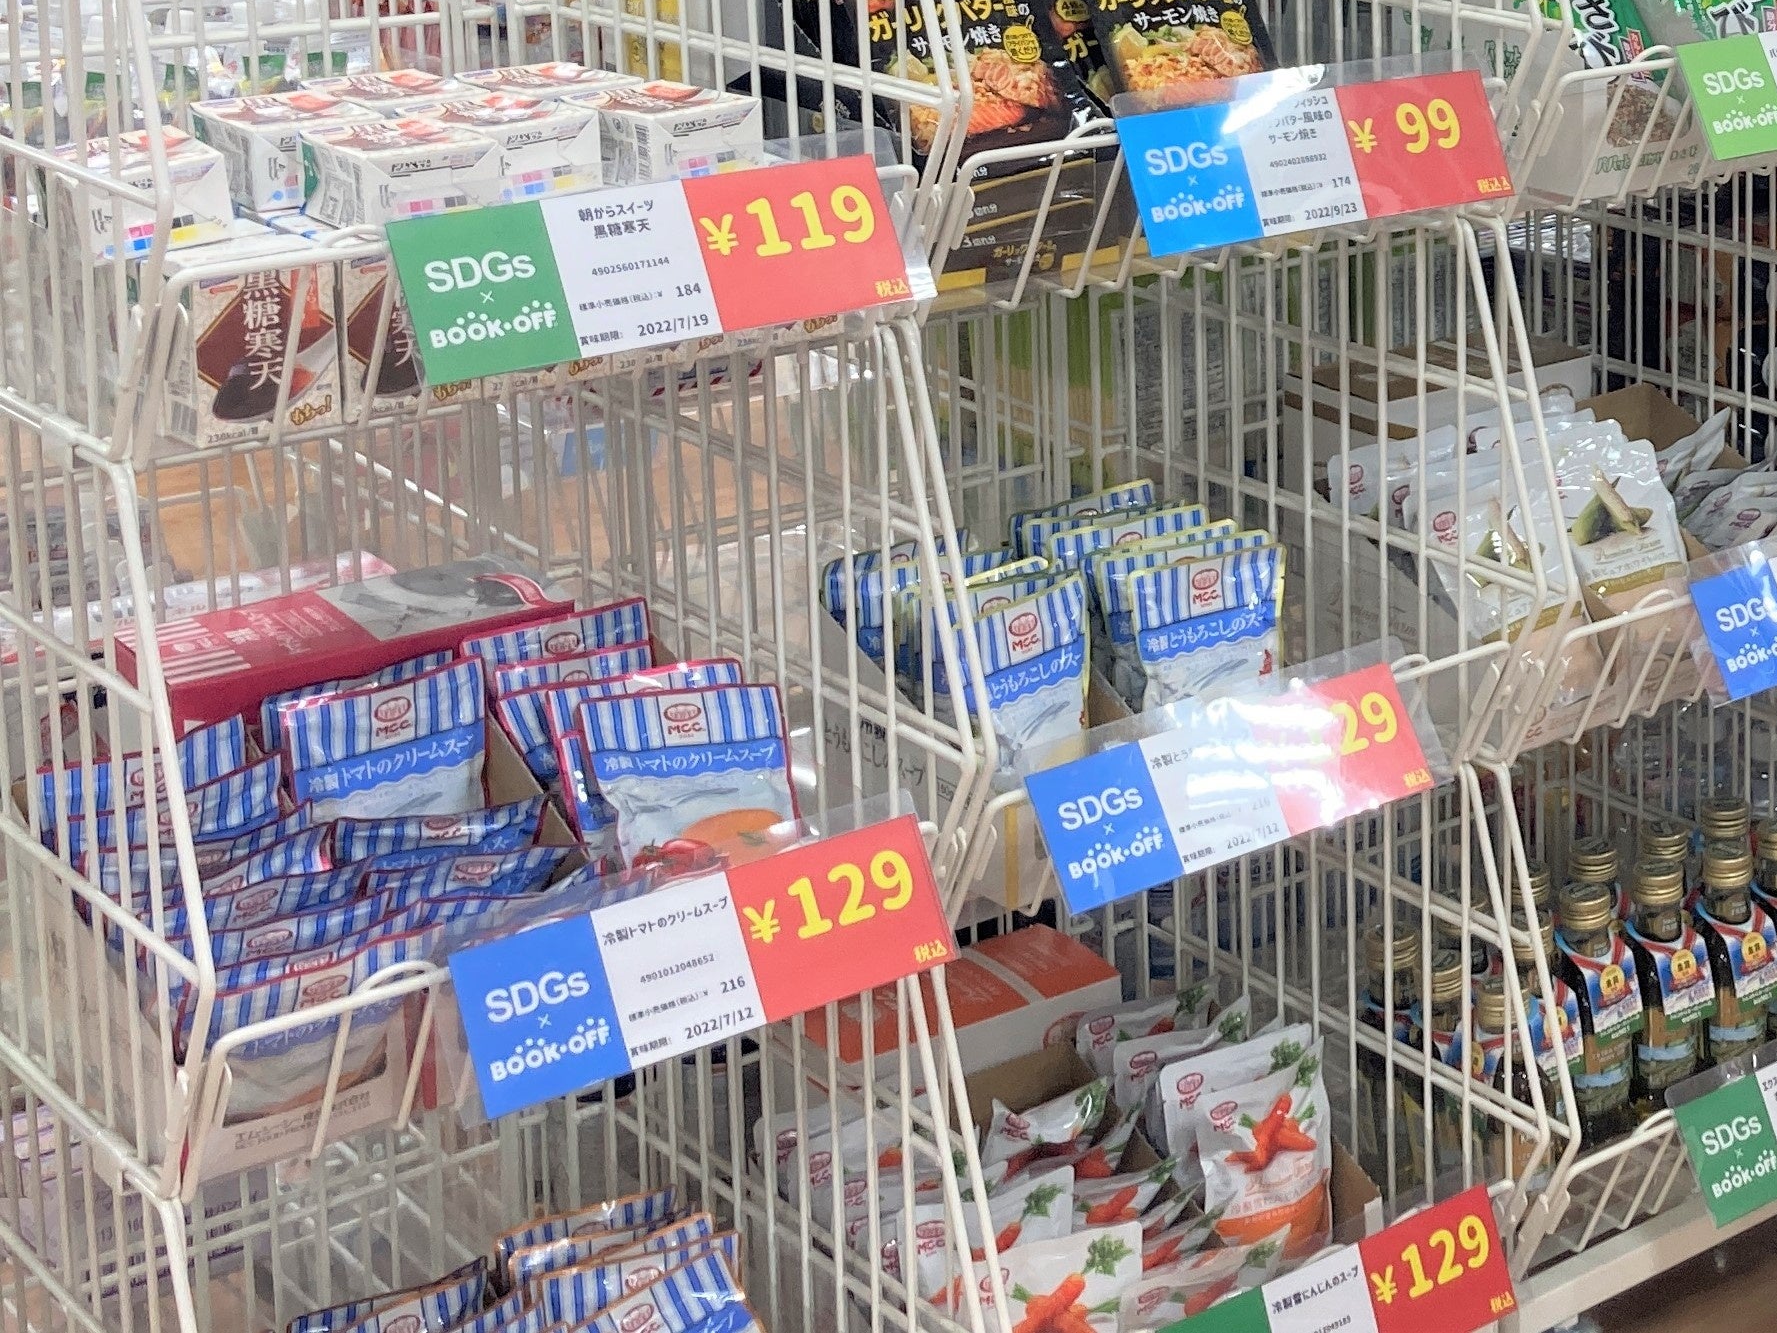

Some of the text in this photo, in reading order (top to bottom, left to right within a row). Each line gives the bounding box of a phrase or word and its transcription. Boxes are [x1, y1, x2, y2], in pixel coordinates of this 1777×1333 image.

[1133, 4, 1220, 32] サーモン焼き
[1702, 66, 1766, 97] SDGs
[1144, 141, 1229, 176] SDGs
[1331, 175, 1352, 191] 174
[578, 199, 655, 223] 朝からスイーツ
[699, 184, 876, 257] ¥119
[1304, 202, 1359, 222] 2022/9/23
[592, 218, 653, 240] 黒糖寒天
[425, 250, 536, 294] SDGs
[590, 256, 671, 277] 4902560171144
[675, 282, 702, 299] 184
[242, 267, 285, 390] 黒糖寒天
[636, 313, 710, 339] 2022/7/19
[1056, 786, 1145, 832] SDGs
[742, 850, 914, 945] ¥129
[602, 895, 730, 948] 冷製トマトのクリームスープ
[484, 969, 591, 1025] SDGs
[719, 975, 747, 995] 216
[683, 1006, 756, 1041] 2022/7/12
[1700, 1115, 1763, 1156] SDGs
[1370, 1214, 1490, 1305] ¥129
